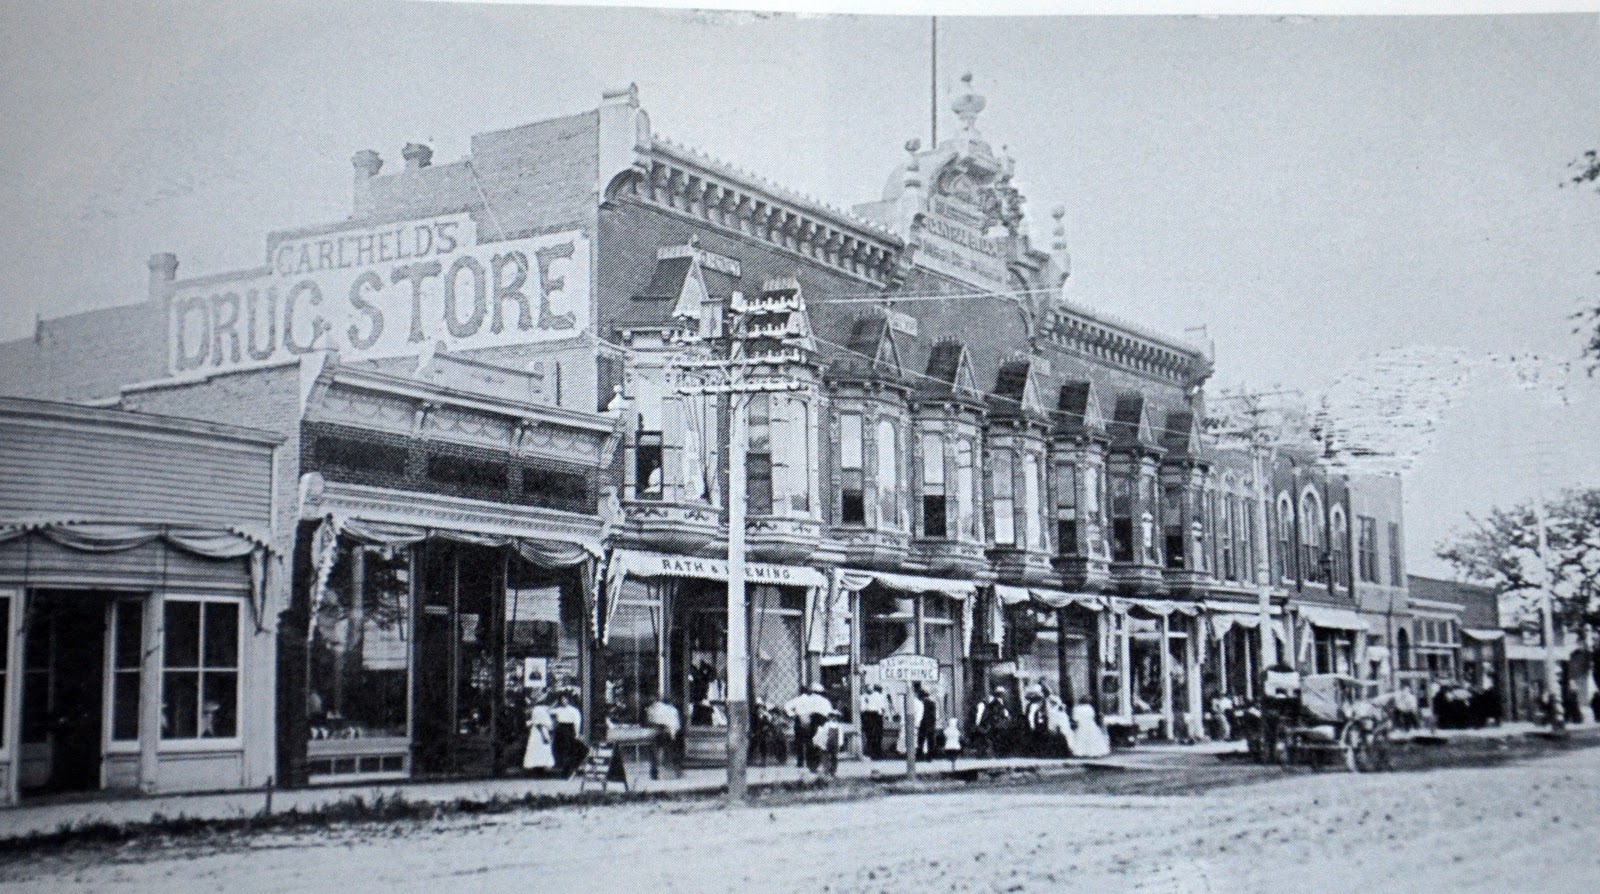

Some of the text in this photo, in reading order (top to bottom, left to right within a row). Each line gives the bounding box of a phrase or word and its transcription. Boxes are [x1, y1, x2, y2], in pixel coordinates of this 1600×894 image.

[176, 241, 577, 371] DRUG STORE
[662, 559, 704, 574] RATH
